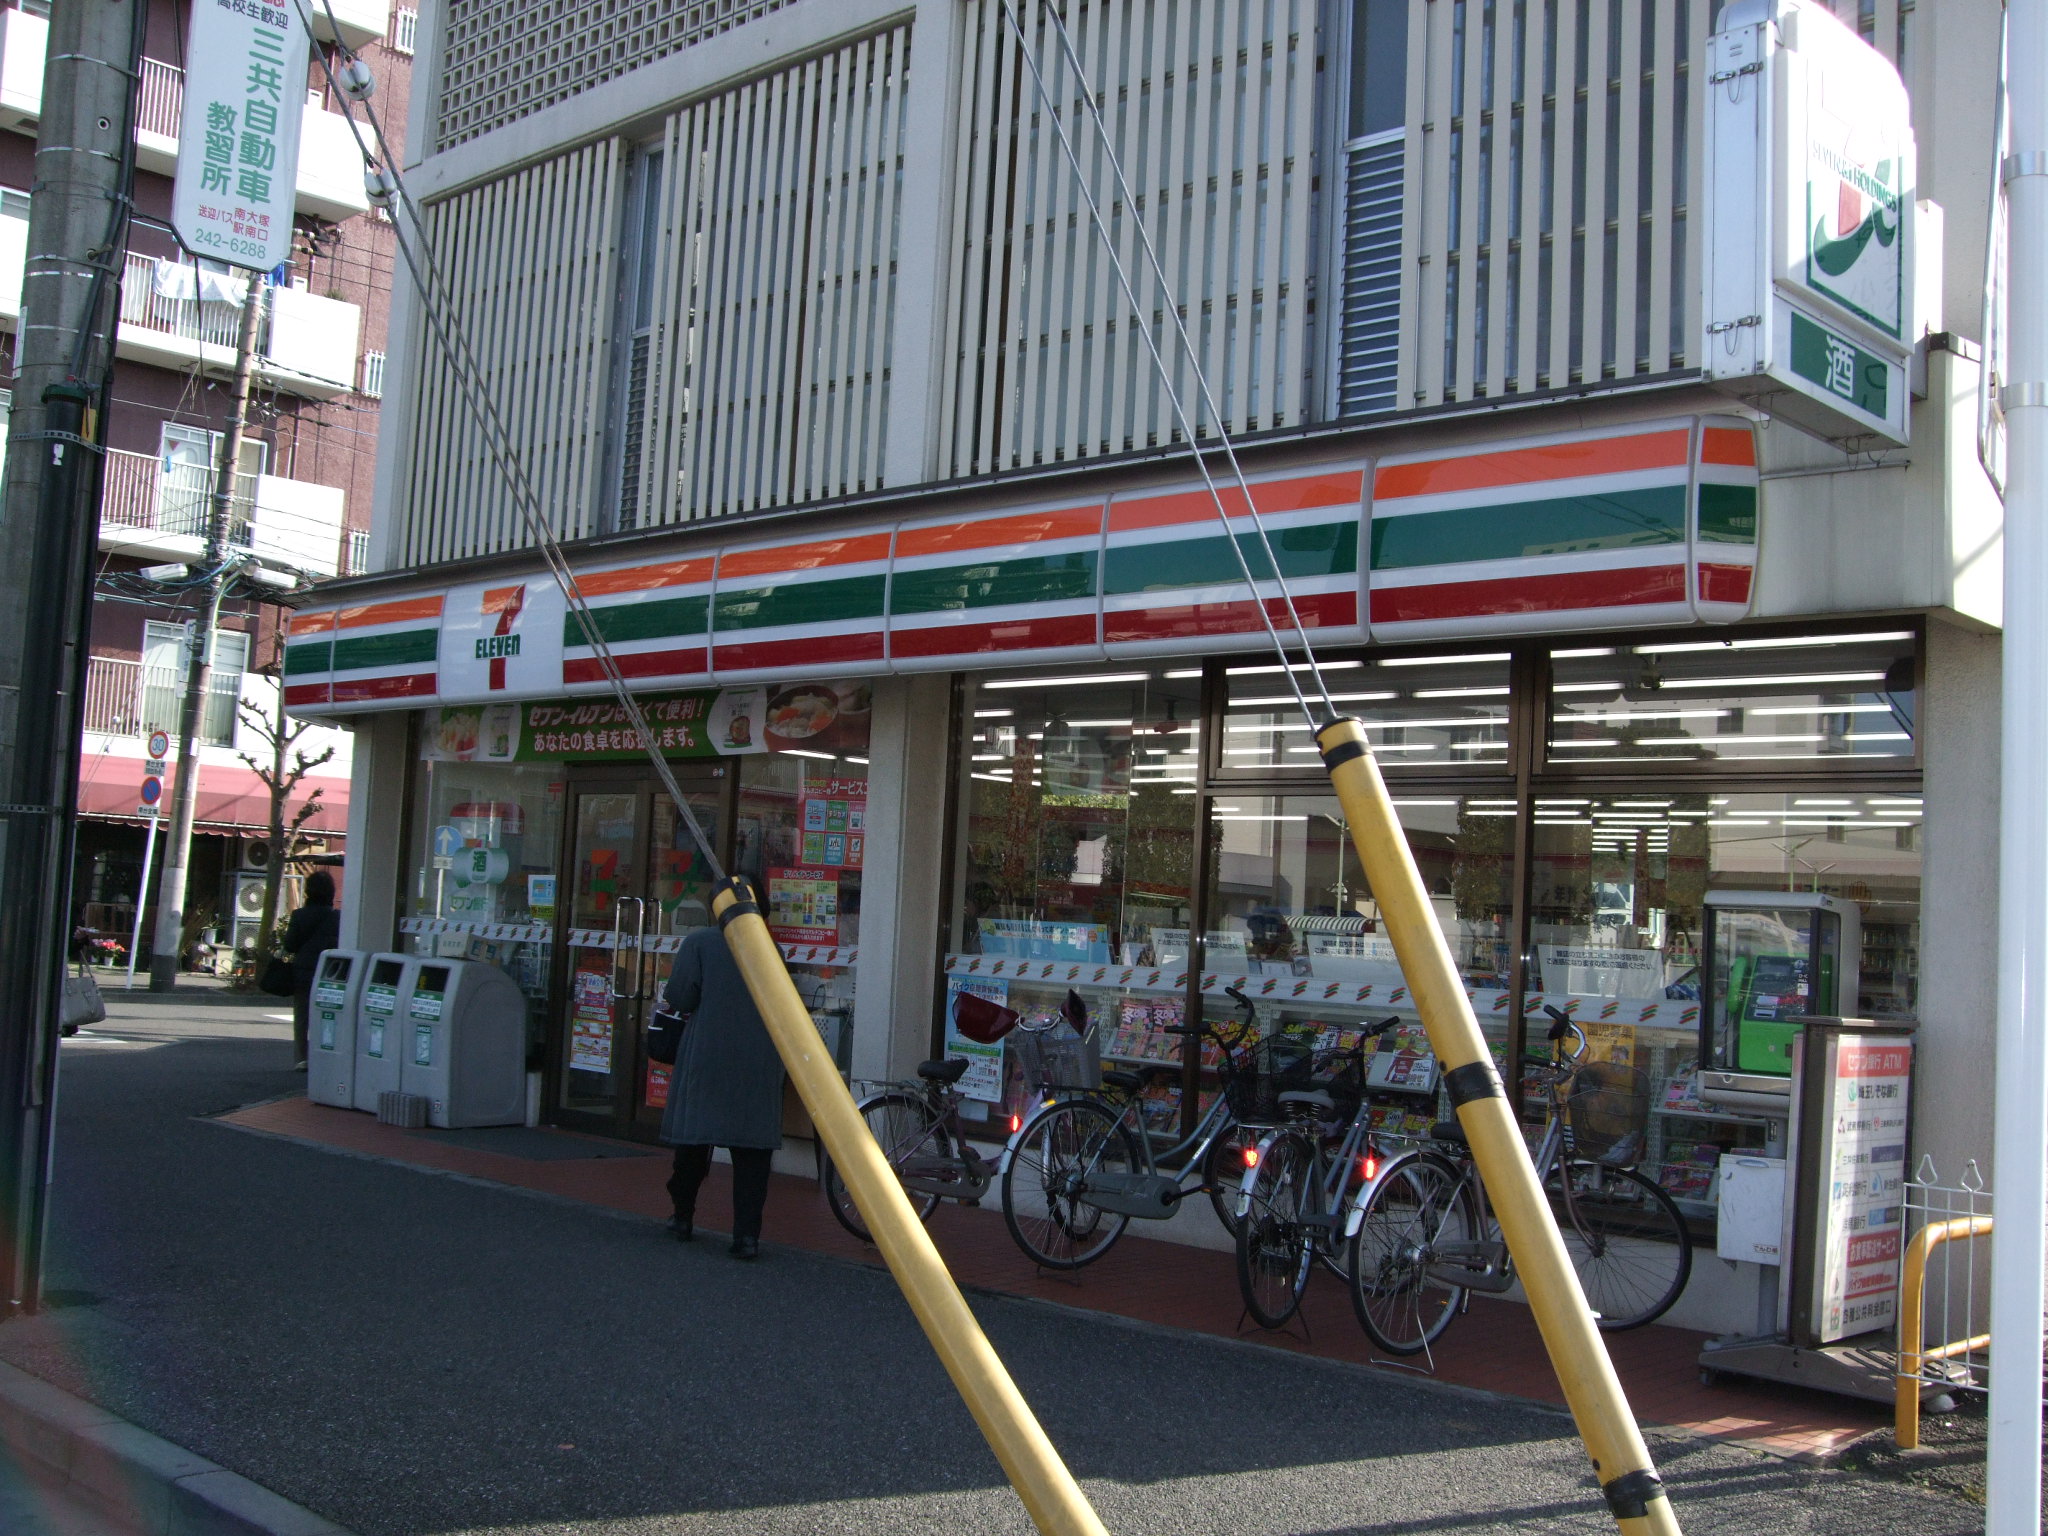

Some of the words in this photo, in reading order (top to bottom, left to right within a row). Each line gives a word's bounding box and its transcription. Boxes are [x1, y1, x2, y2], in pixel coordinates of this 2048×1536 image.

[236, 27, 285, 204] 三共自動車
[200, 101, 238, 196] 教習所
[1853, 166, 1897, 213] HOLDINGS
[232, 221, 269, 242] 駅南口
[234, 207, 270, 228] 南大塚
[194, 228, 266, 260] 242-6288
[1825, 334, 1856, 398] 酒
[481, 583, 526, 691] 7
[152, 738, 165, 752] 30
[472, 850, 488, 873] 酒
[1883, 1053, 1902, 1070] ATM
